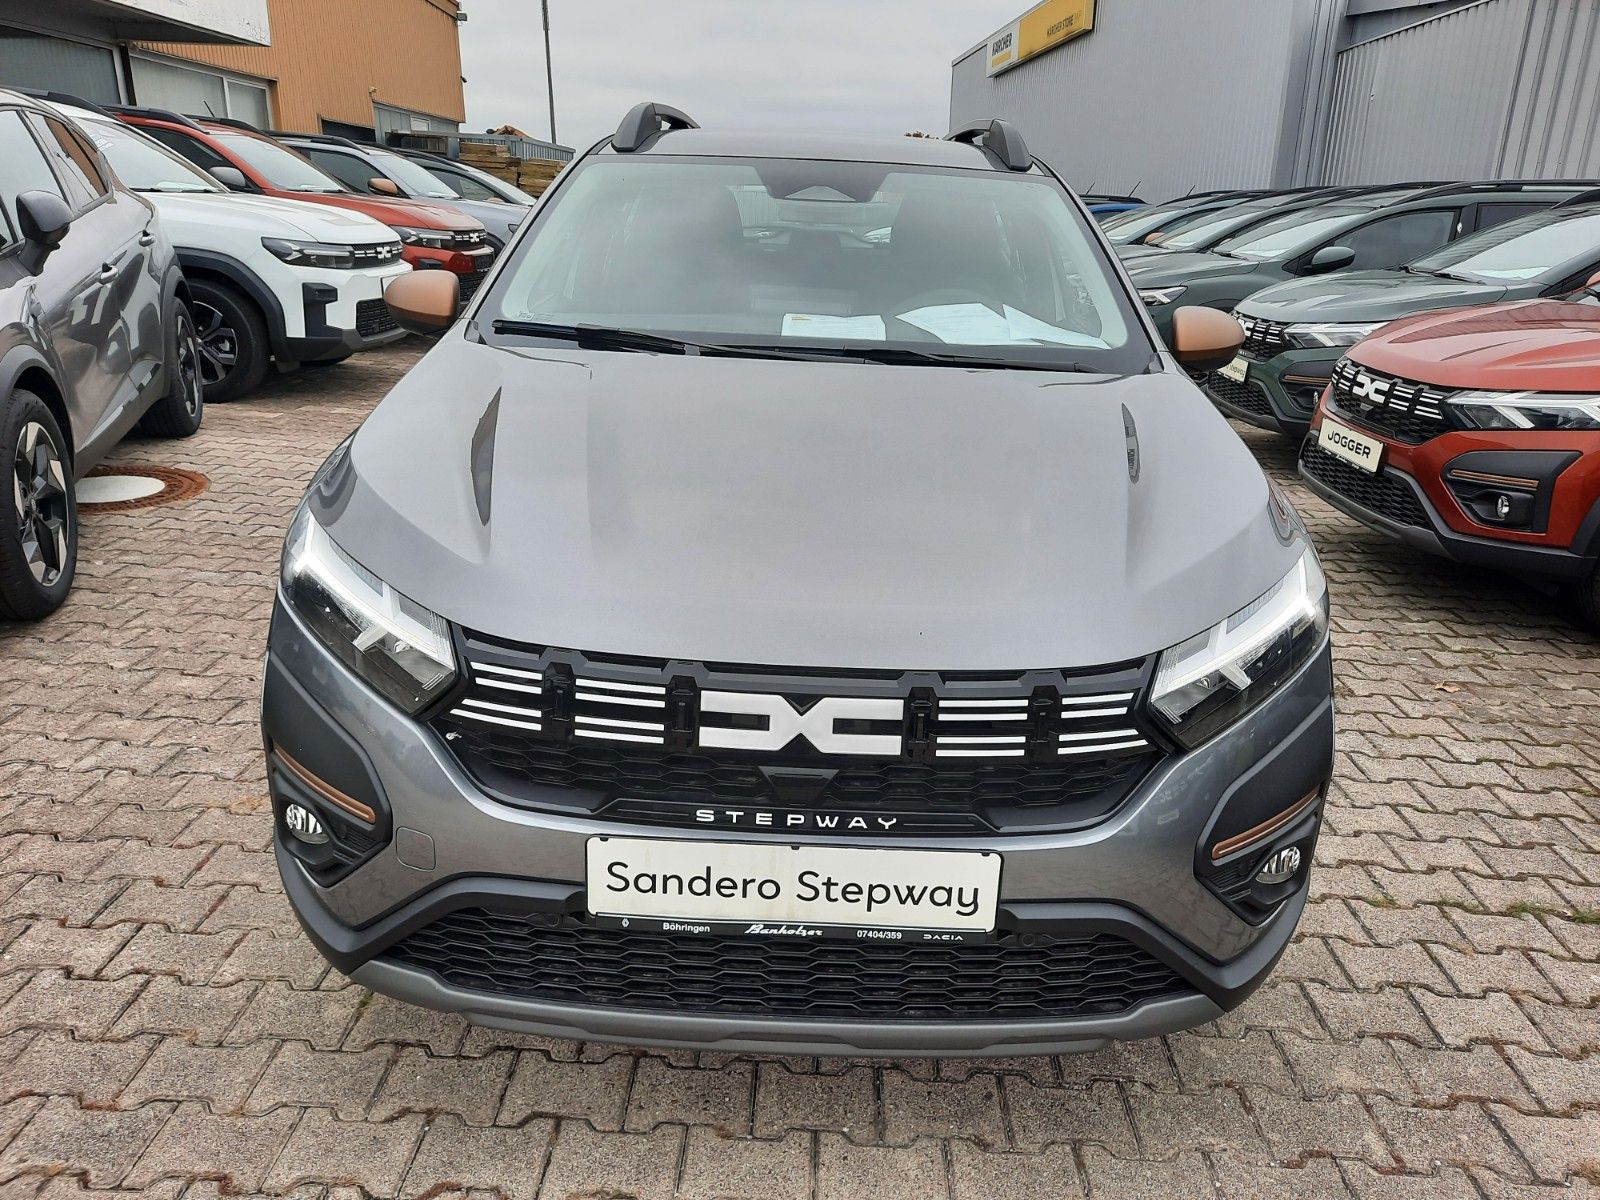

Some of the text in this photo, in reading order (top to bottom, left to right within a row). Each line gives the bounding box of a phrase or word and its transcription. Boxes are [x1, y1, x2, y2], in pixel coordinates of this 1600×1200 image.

[1327, 430, 1371, 459] JOGGER
[696, 809, 897, 830] STEPWAY
[606, 861, 979, 916] Sandero Stepway
[662, 922, 711, 934] Böhringen
[744, 923, 823, 937] Banholzer
[857, 929, 902, 940] 07404/359
